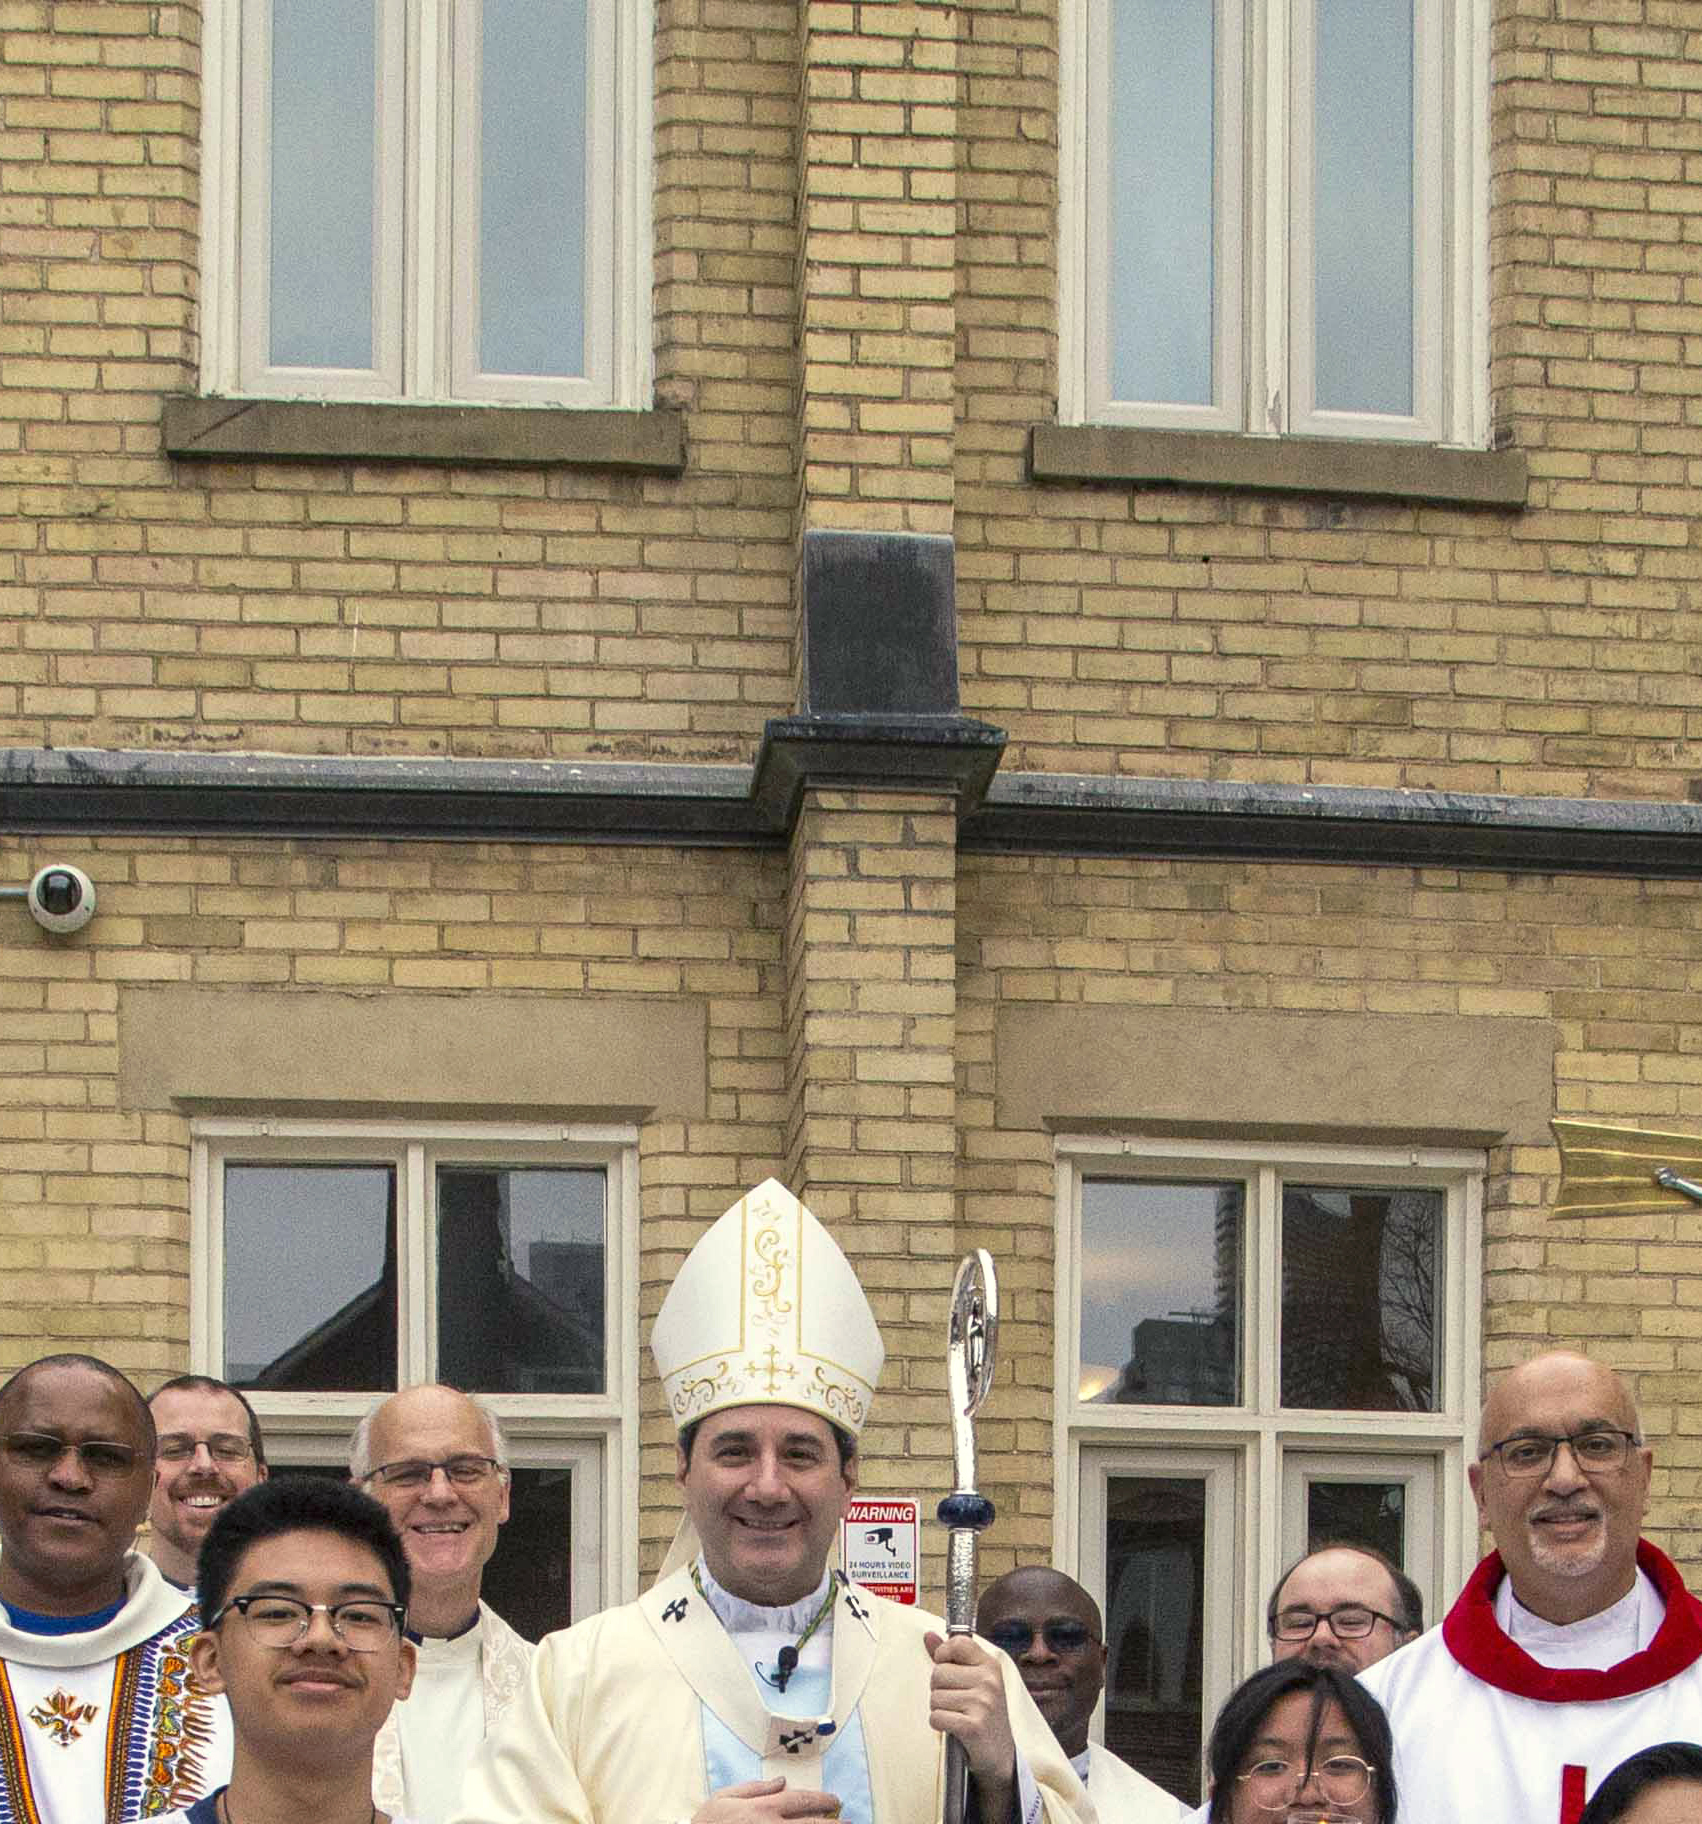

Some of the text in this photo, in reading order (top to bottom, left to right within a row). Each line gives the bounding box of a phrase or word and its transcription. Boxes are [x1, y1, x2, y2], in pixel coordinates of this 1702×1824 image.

[847, 1506, 914, 1520] WARNING
[849, 1561, 911, 1569] 24 HOURS VIDEO
[851, 1571, 909, 1579] SURVEILLANCE
